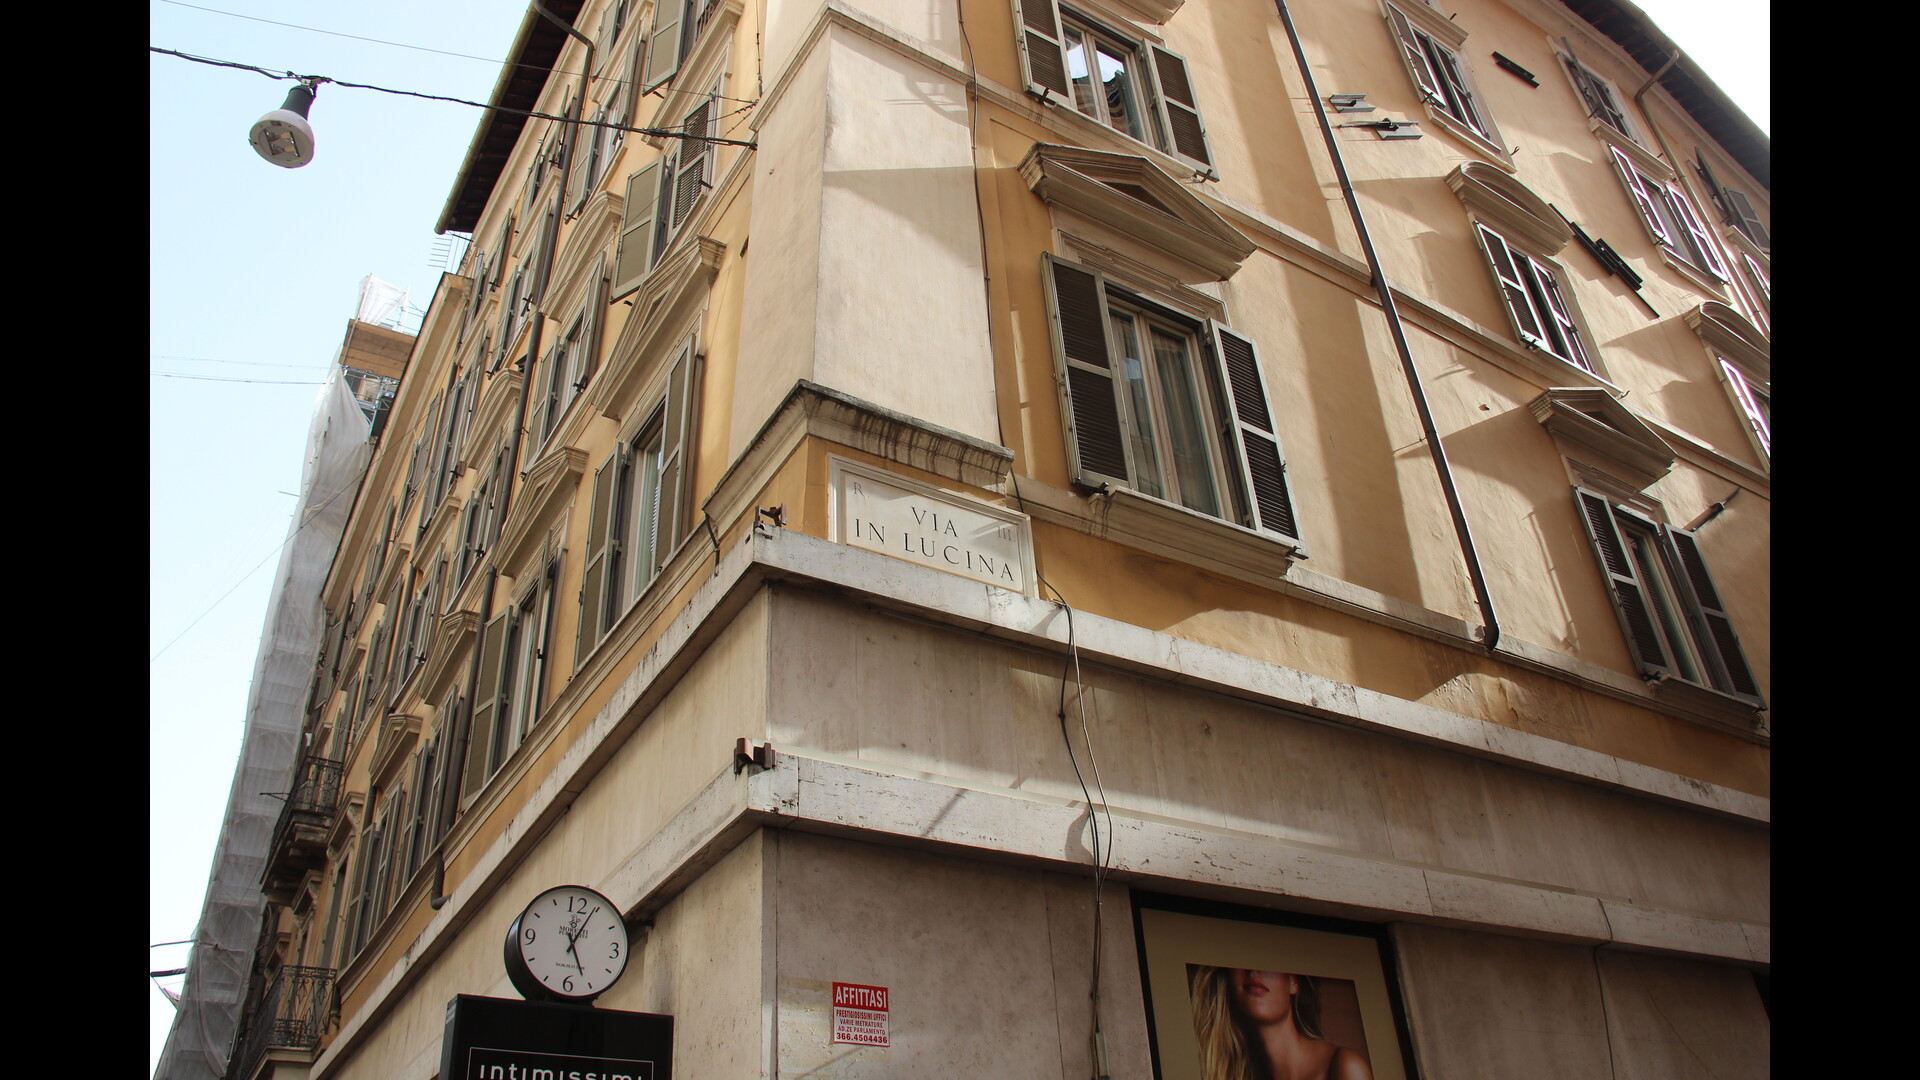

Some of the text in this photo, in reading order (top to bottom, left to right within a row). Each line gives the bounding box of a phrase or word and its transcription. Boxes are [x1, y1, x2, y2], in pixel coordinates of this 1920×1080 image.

[911, 506, 959, 538] VIA
[855, 518, 1015, 582] IN LUCINA
[566, 896, 588, 915] 12
[525, 928, 536, 945] 9
[609, 942, 619, 959] 3
[562, 975, 574, 992] 6
[836, 986, 886, 1008] AFFITTASI
[854, 1027, 885, 1035] PARLAMENTO
[855, 1020, 883, 1028] METRATURE
[837, 1033, 887, 1043] 366.4504436
[479, 1063, 643, 1080] intimiss
